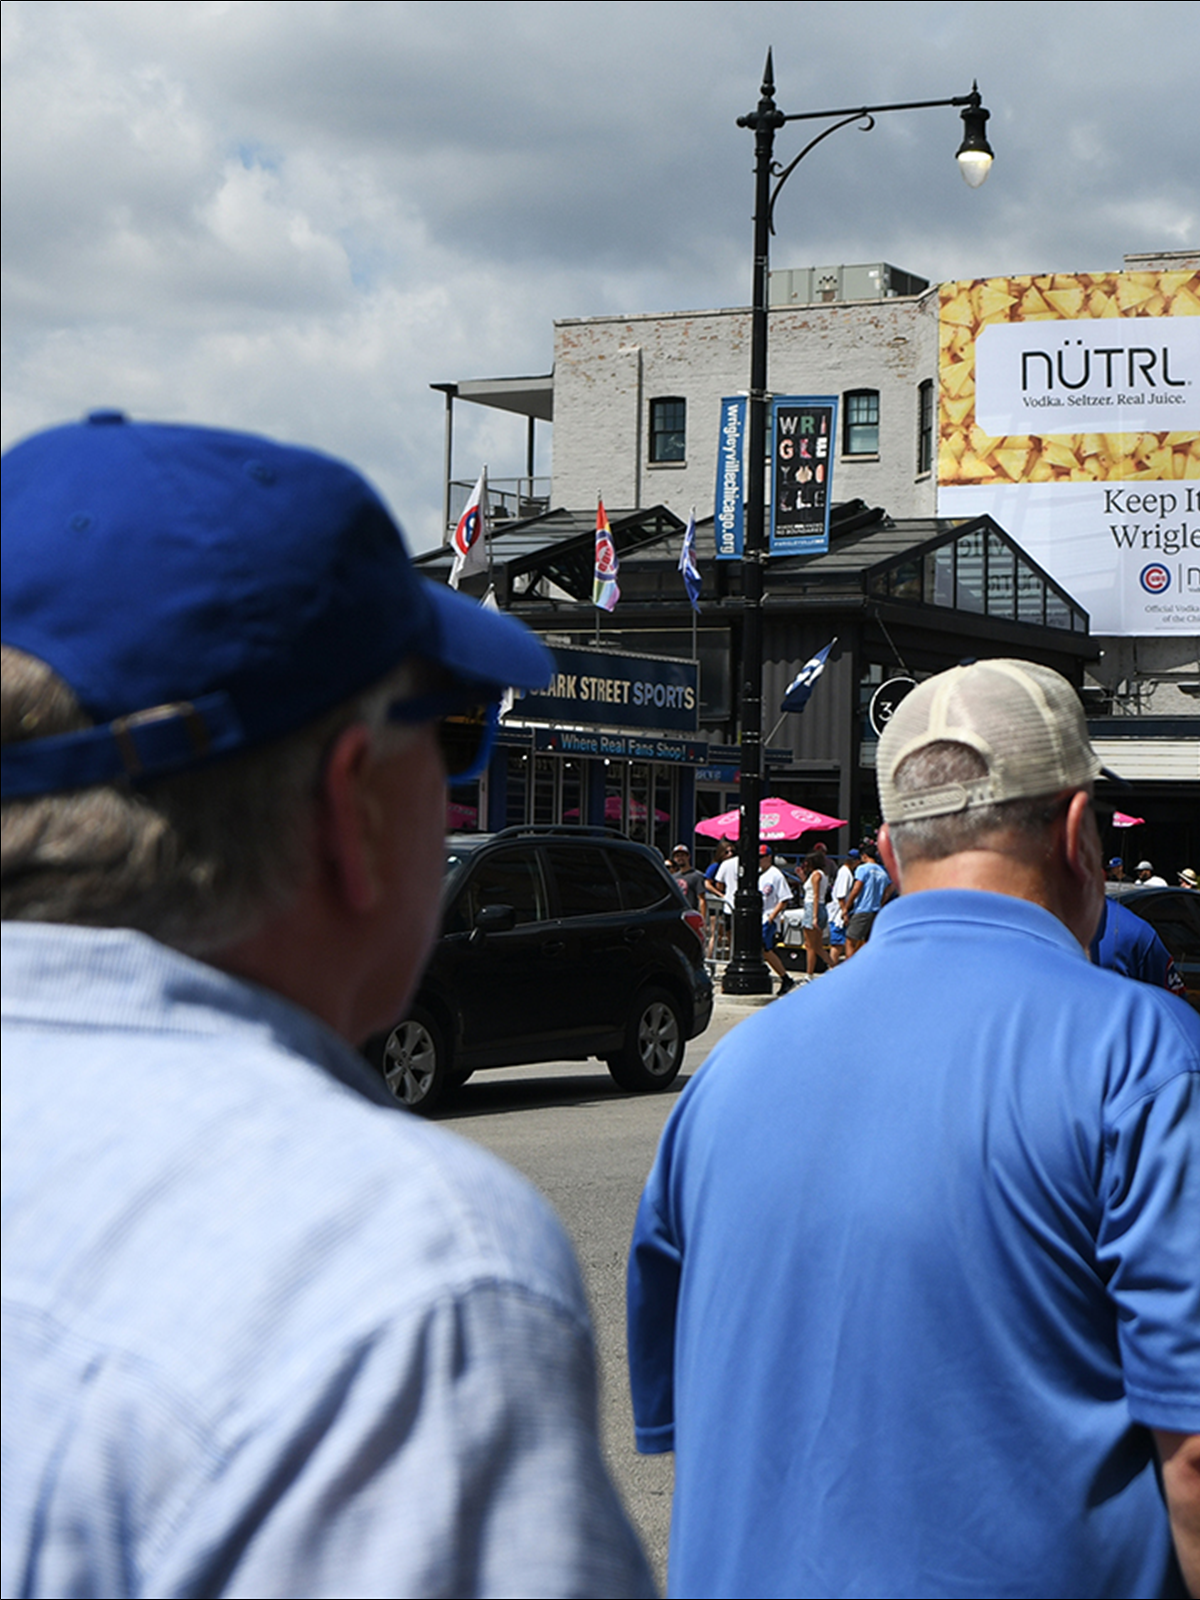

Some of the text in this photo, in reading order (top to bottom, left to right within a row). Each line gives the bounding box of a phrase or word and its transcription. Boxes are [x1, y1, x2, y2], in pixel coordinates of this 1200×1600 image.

[1022, 391, 1187, 408] Vodka. Seltzer. Real Juice.
[719, 403, 742, 555] wrigleyvillechicago.org
[1103, 488, 1178, 519] Keep
[1144, 605, 1174, 613] Official
[1175, 605, 1200, 613] Vodka
[1162, 615, 1171, 623] of
[1172, 614, 1184, 622] the
[580, 676, 630, 704] STREET
[633, 681, 695, 710] SPORTS
[561, 733, 687, 761] Where Real Fans Shop!
